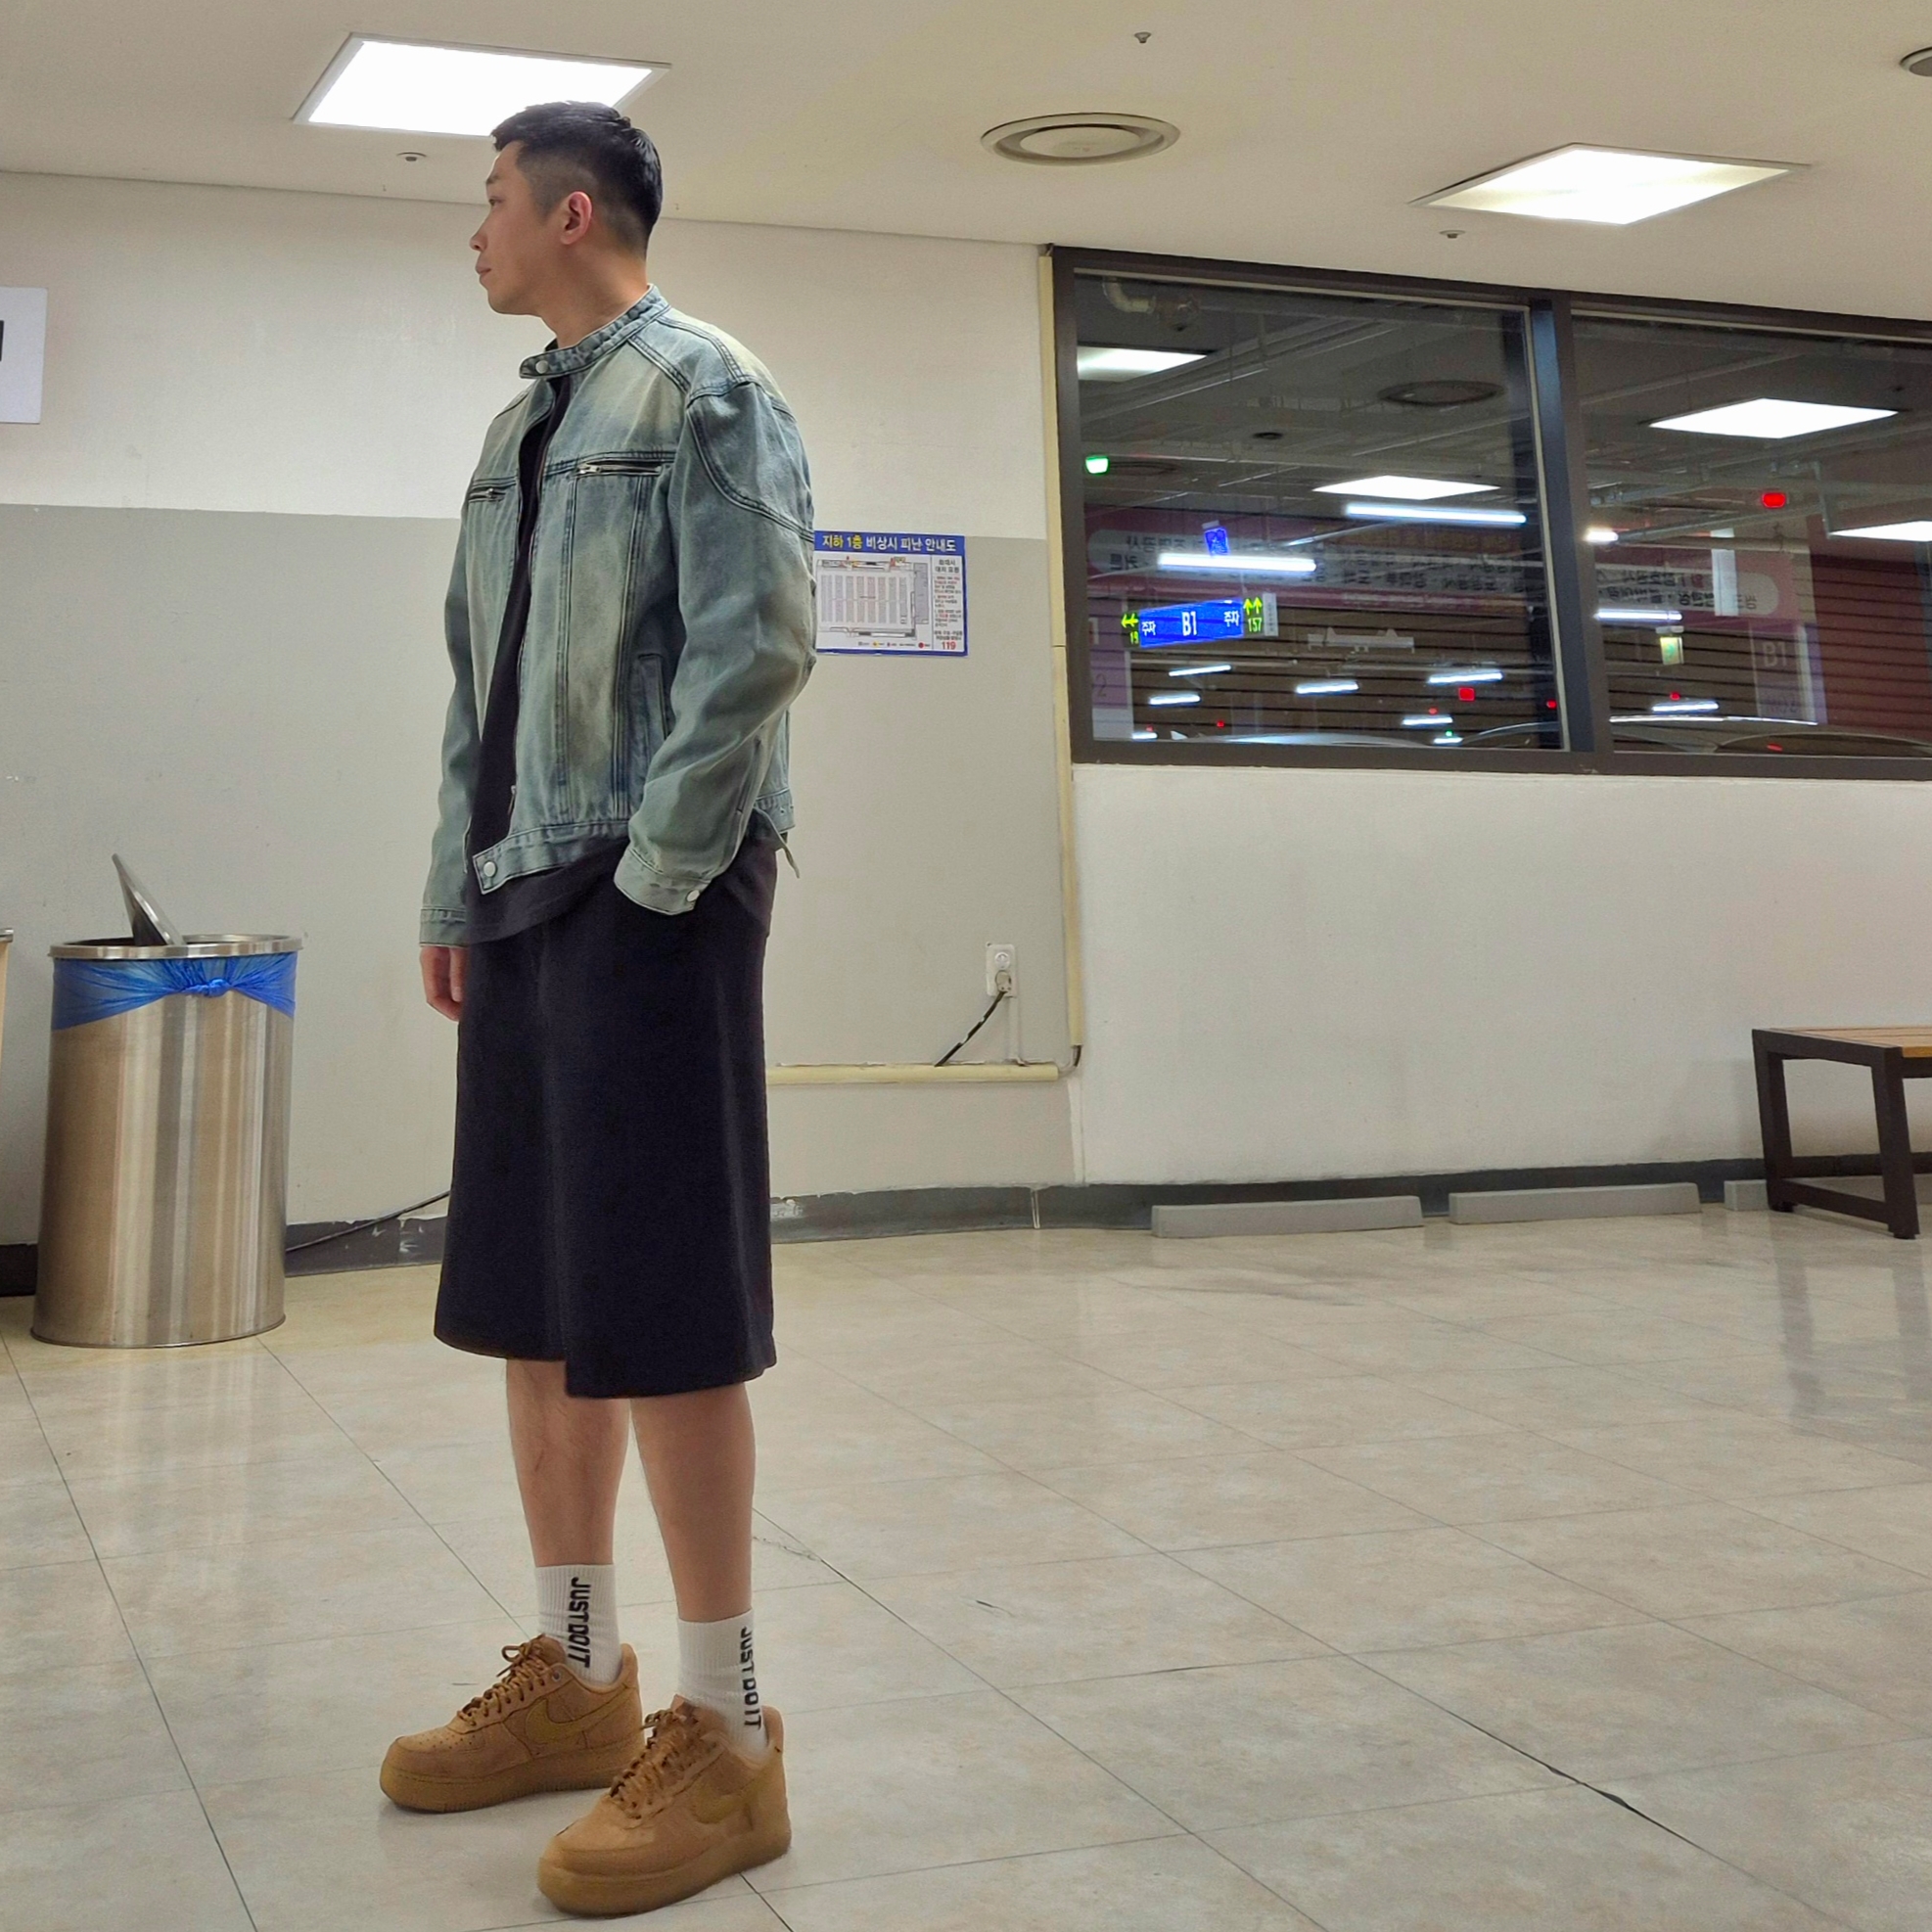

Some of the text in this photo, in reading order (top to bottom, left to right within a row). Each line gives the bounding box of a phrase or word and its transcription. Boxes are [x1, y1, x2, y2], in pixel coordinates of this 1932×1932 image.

[822, 534, 956, 552] 지하 1층 비상시 피난 안내도
[1181, 611, 1197, 636] B1
[1248, 618, 1262, 632] 157
[942, 641, 956, 650] 119
[568, 1577, 591, 1622] JUST
[740, 1626, 755, 1674] JUST
